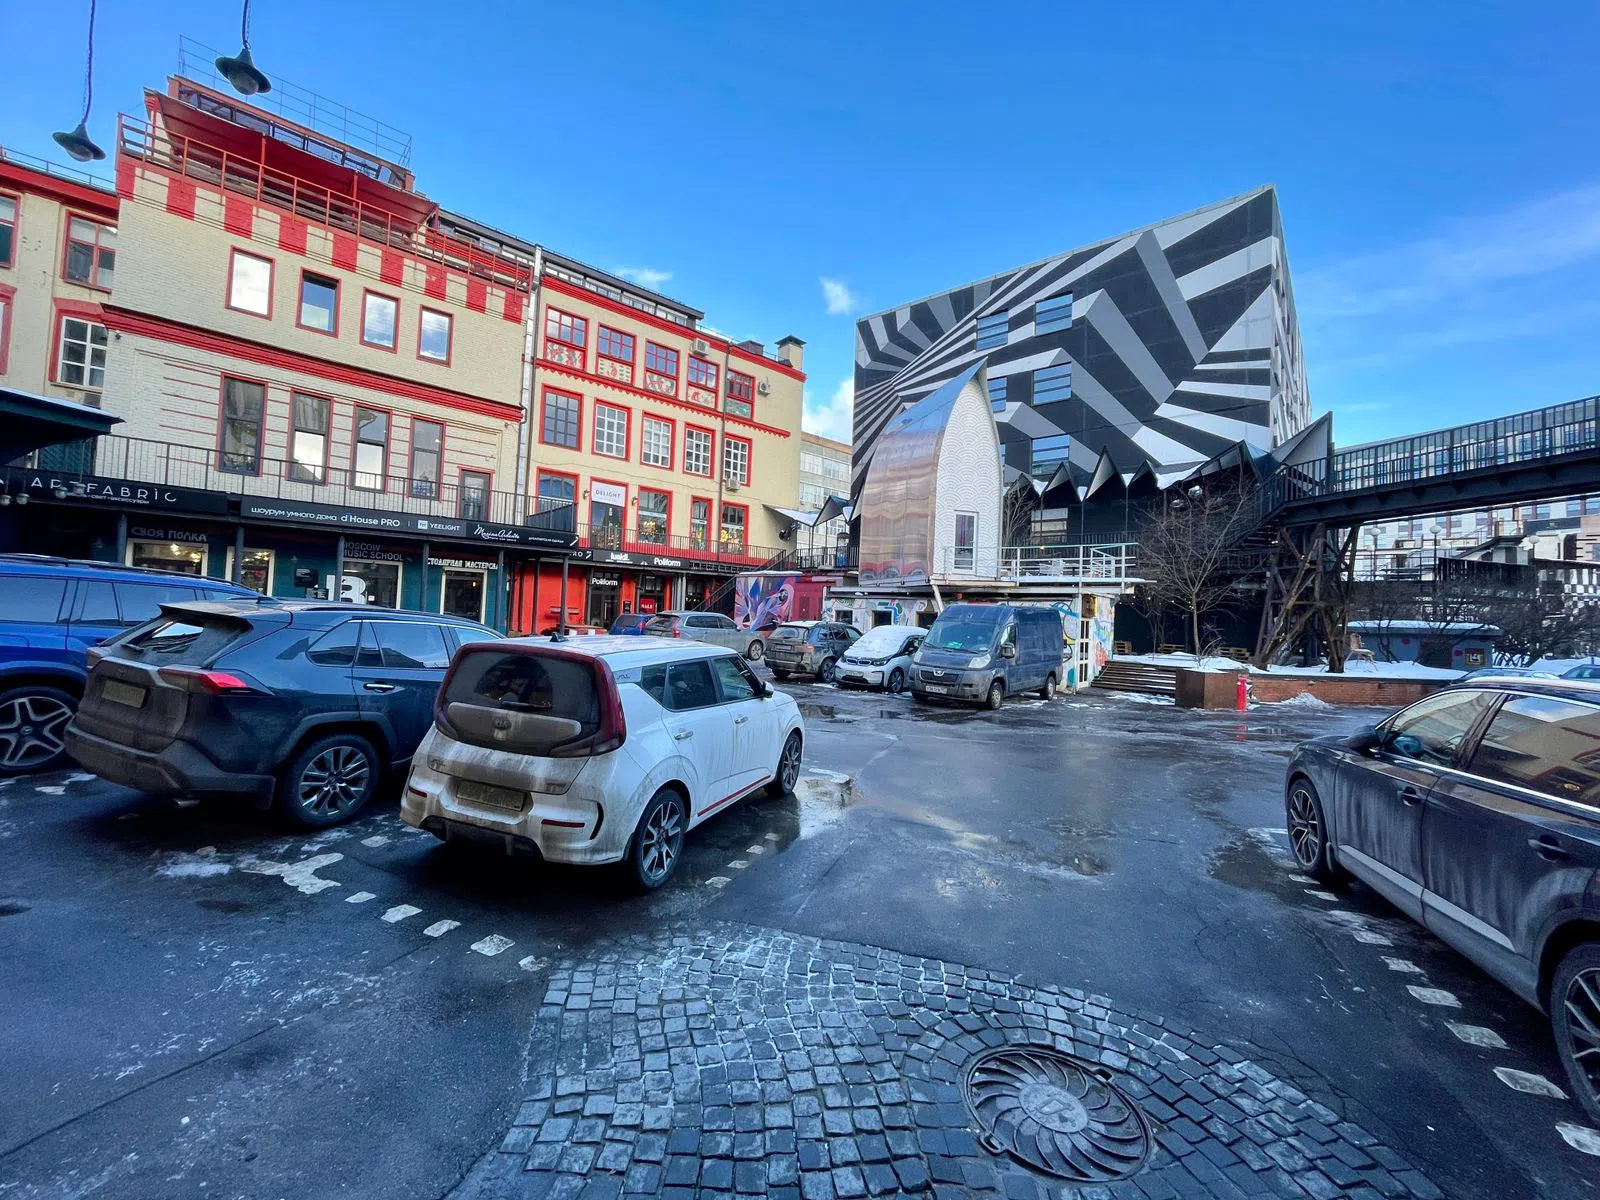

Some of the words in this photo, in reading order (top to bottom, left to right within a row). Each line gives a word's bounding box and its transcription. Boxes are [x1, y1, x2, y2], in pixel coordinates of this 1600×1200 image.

[595, 489, 621, 499] DELIGHT
[251, 507, 285, 517] шоурум
[286, 510, 315, 518] умного
[316, 513, 337, 521] дома
[380, 518, 401, 527] PRO
[430, 522, 460, 531] YEELIGHT
[131, 526, 164, 539] СВОЯ
[168, 530, 208, 542] ПОЛКА
[370, 551, 404, 561] SCHOOL
[653, 557, 681, 567] Poliform
[591, 577, 619, 586] Poliform
